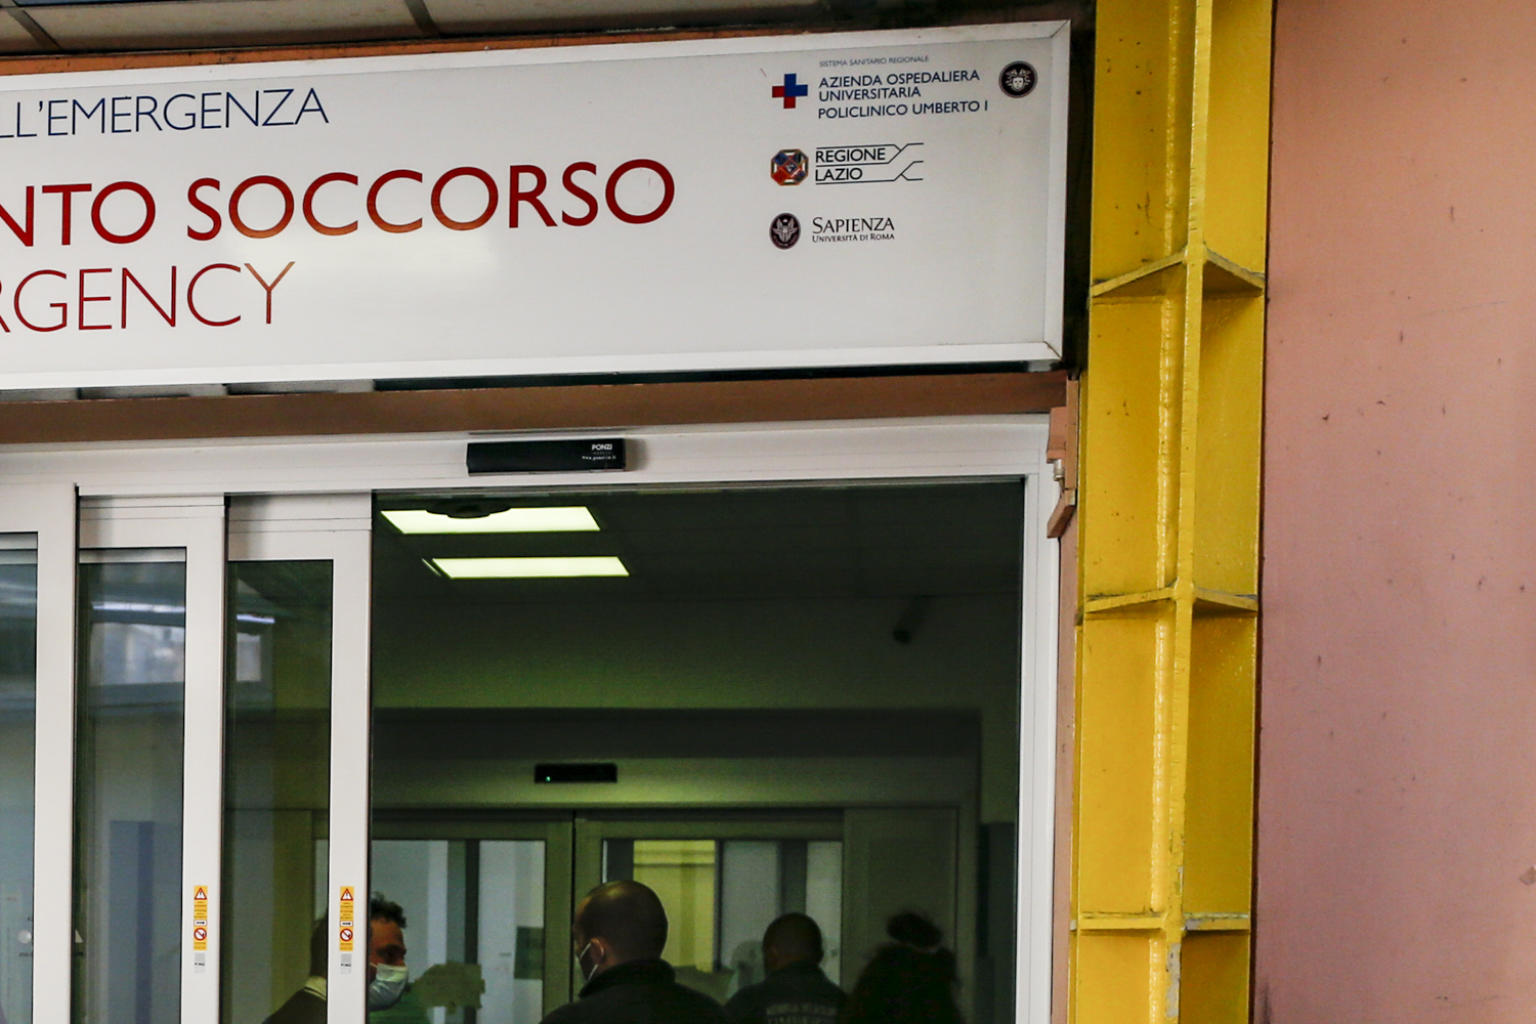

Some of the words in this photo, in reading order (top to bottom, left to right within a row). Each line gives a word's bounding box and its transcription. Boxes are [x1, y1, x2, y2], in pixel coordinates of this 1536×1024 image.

[818, 74, 882, 88] AZIENDA
[886, 70, 980, 85] OSPEDALIERA
[818, 86, 921, 102] UNIVERSITARIA
[818, 104, 908, 119] POLICLINICO
[912, 101, 980, 115] UMBERTO
[984, 100, 989, 112] I
[815, 147, 886, 163] REGIONE
[815, 167, 863, 182] LAZIO
[186, 158, 675, 242] SOCCORSO
[812, 216, 895, 234] SAPIENZA
